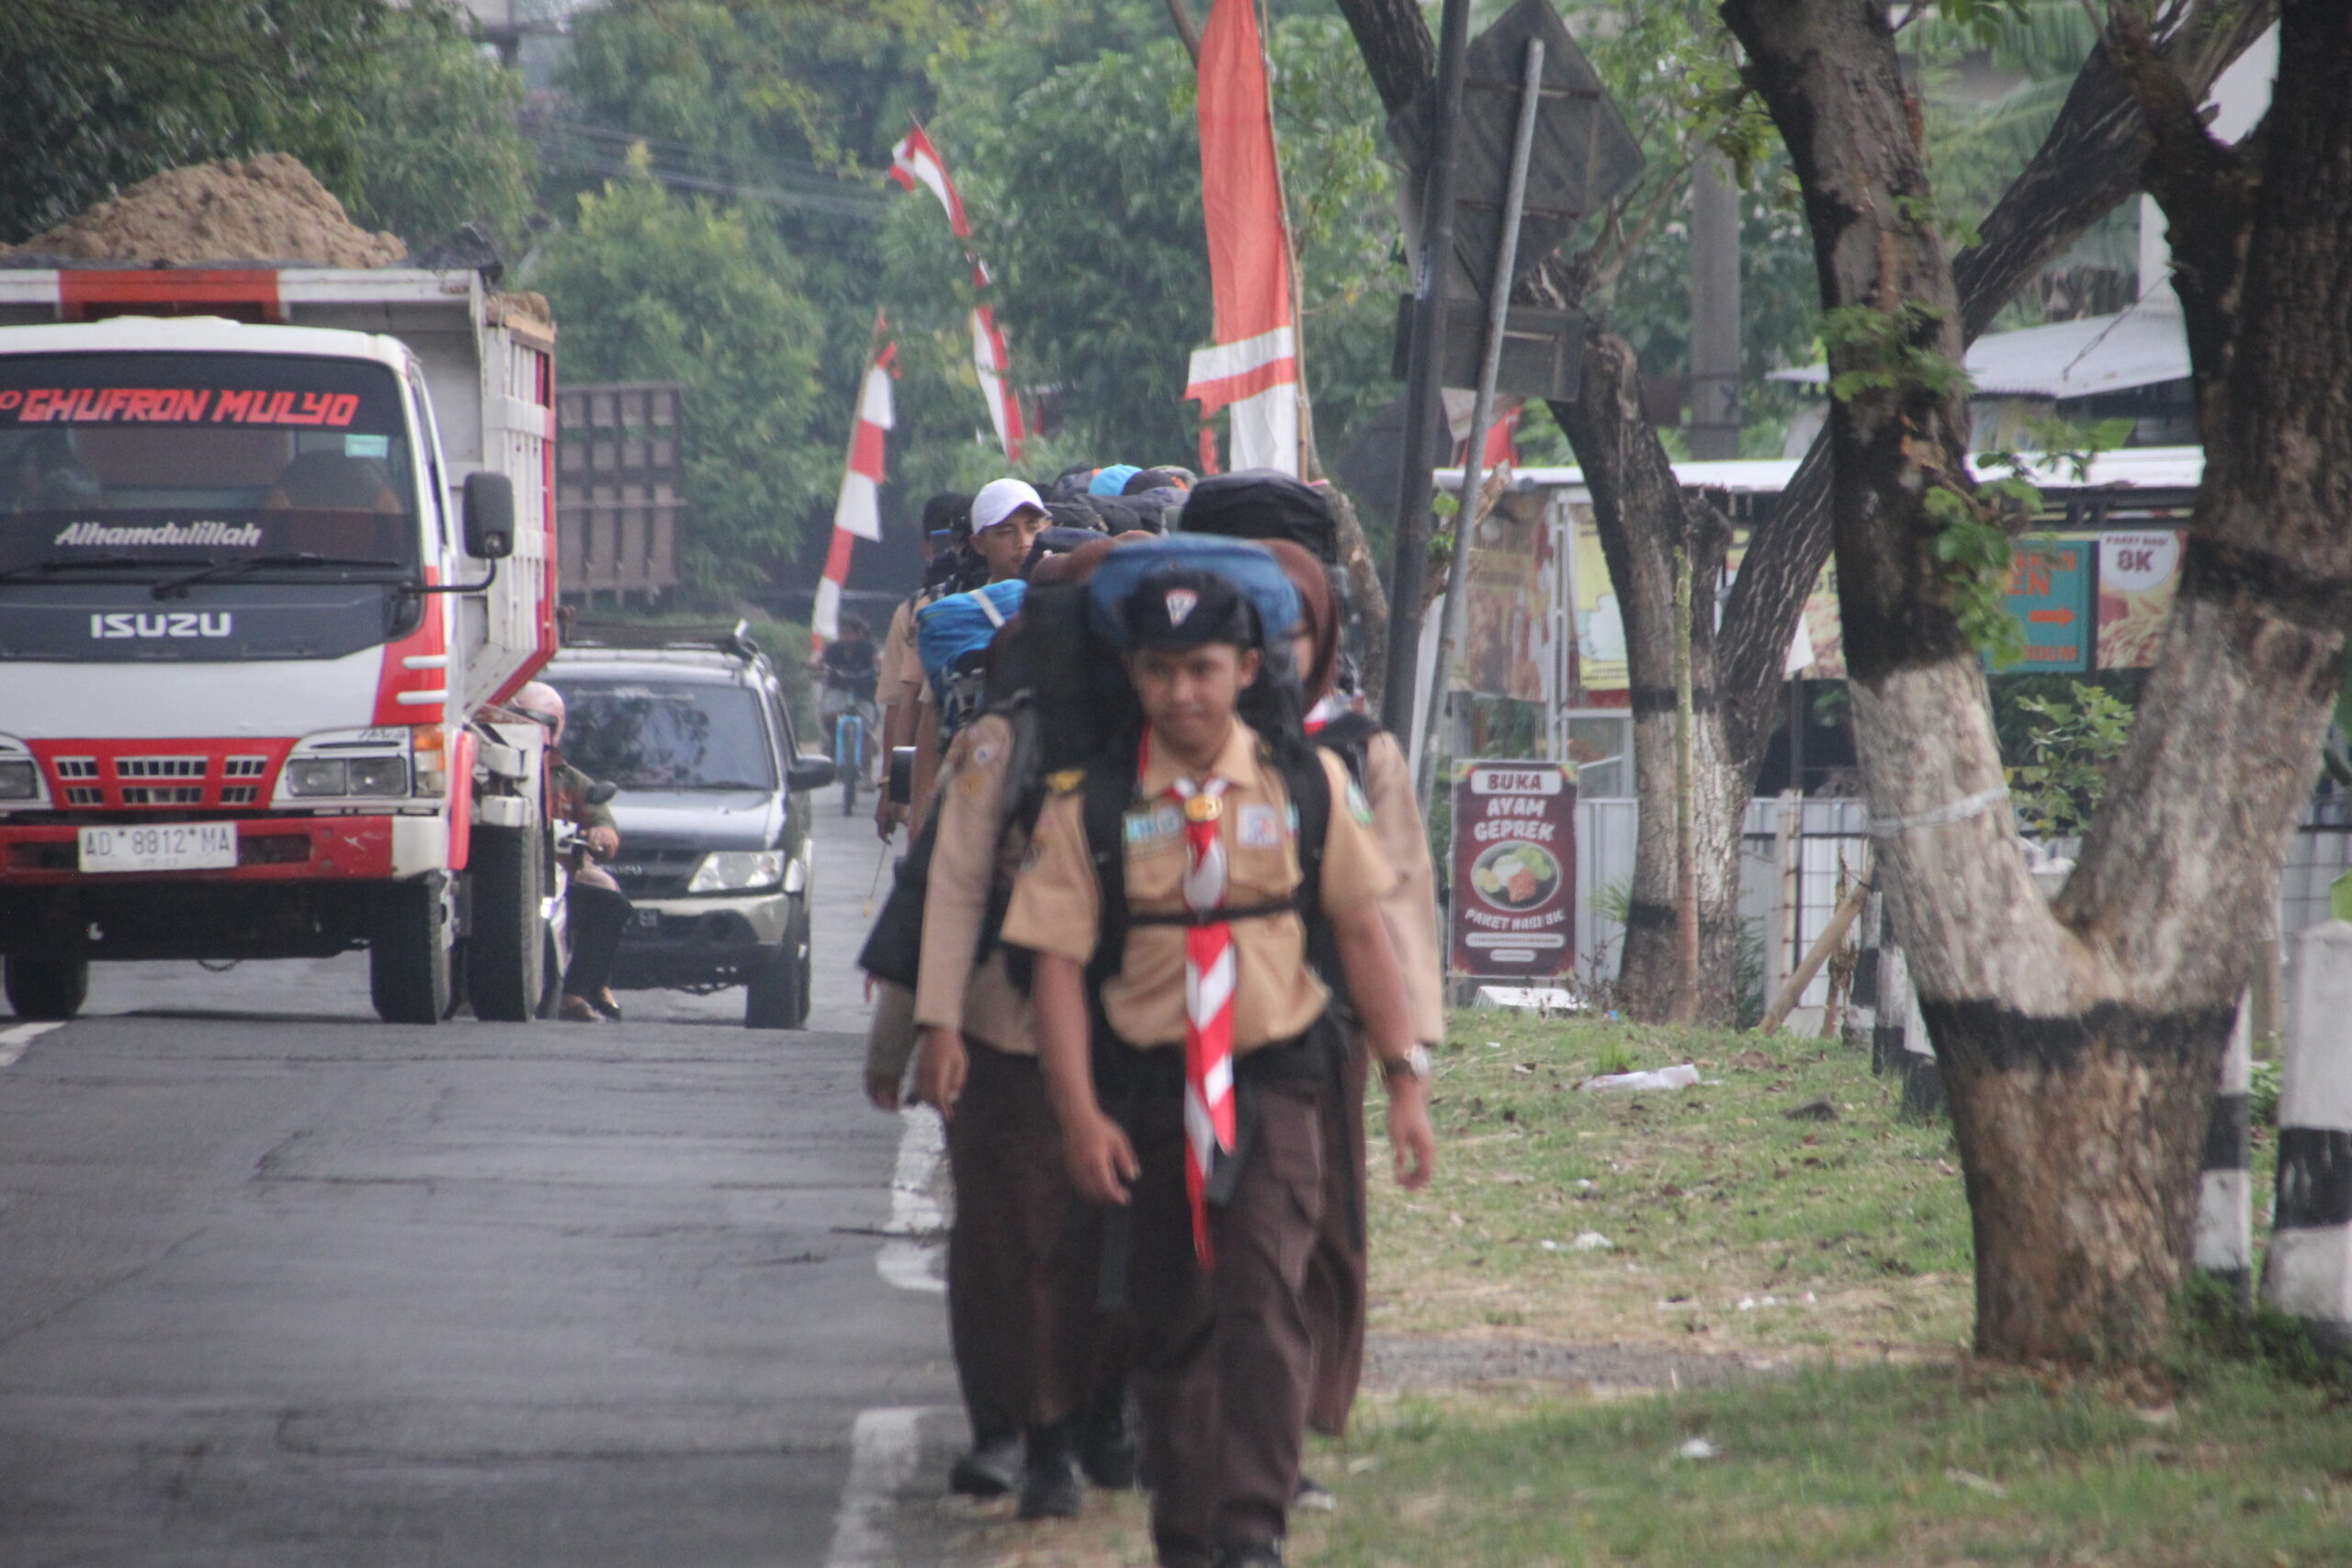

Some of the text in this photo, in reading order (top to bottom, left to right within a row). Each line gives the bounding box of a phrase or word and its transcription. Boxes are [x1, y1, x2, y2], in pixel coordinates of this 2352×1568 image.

[18, 389, 211, 423] GHUFRON
[210, 389, 360, 426] MULYO
[54, 521, 262, 547] Alhamdulillah
[2118, 549, 2154, 571] 8K
[90, 612, 232, 638] ISUZU
[1487, 773, 1543, 790] BUKA
[1487, 797, 1546, 818] AYAM
[1474, 819, 1555, 841] GEPREK
[85, 828, 231, 857] AD 8812 MA
[1464, 908, 1510, 931] PAKET
